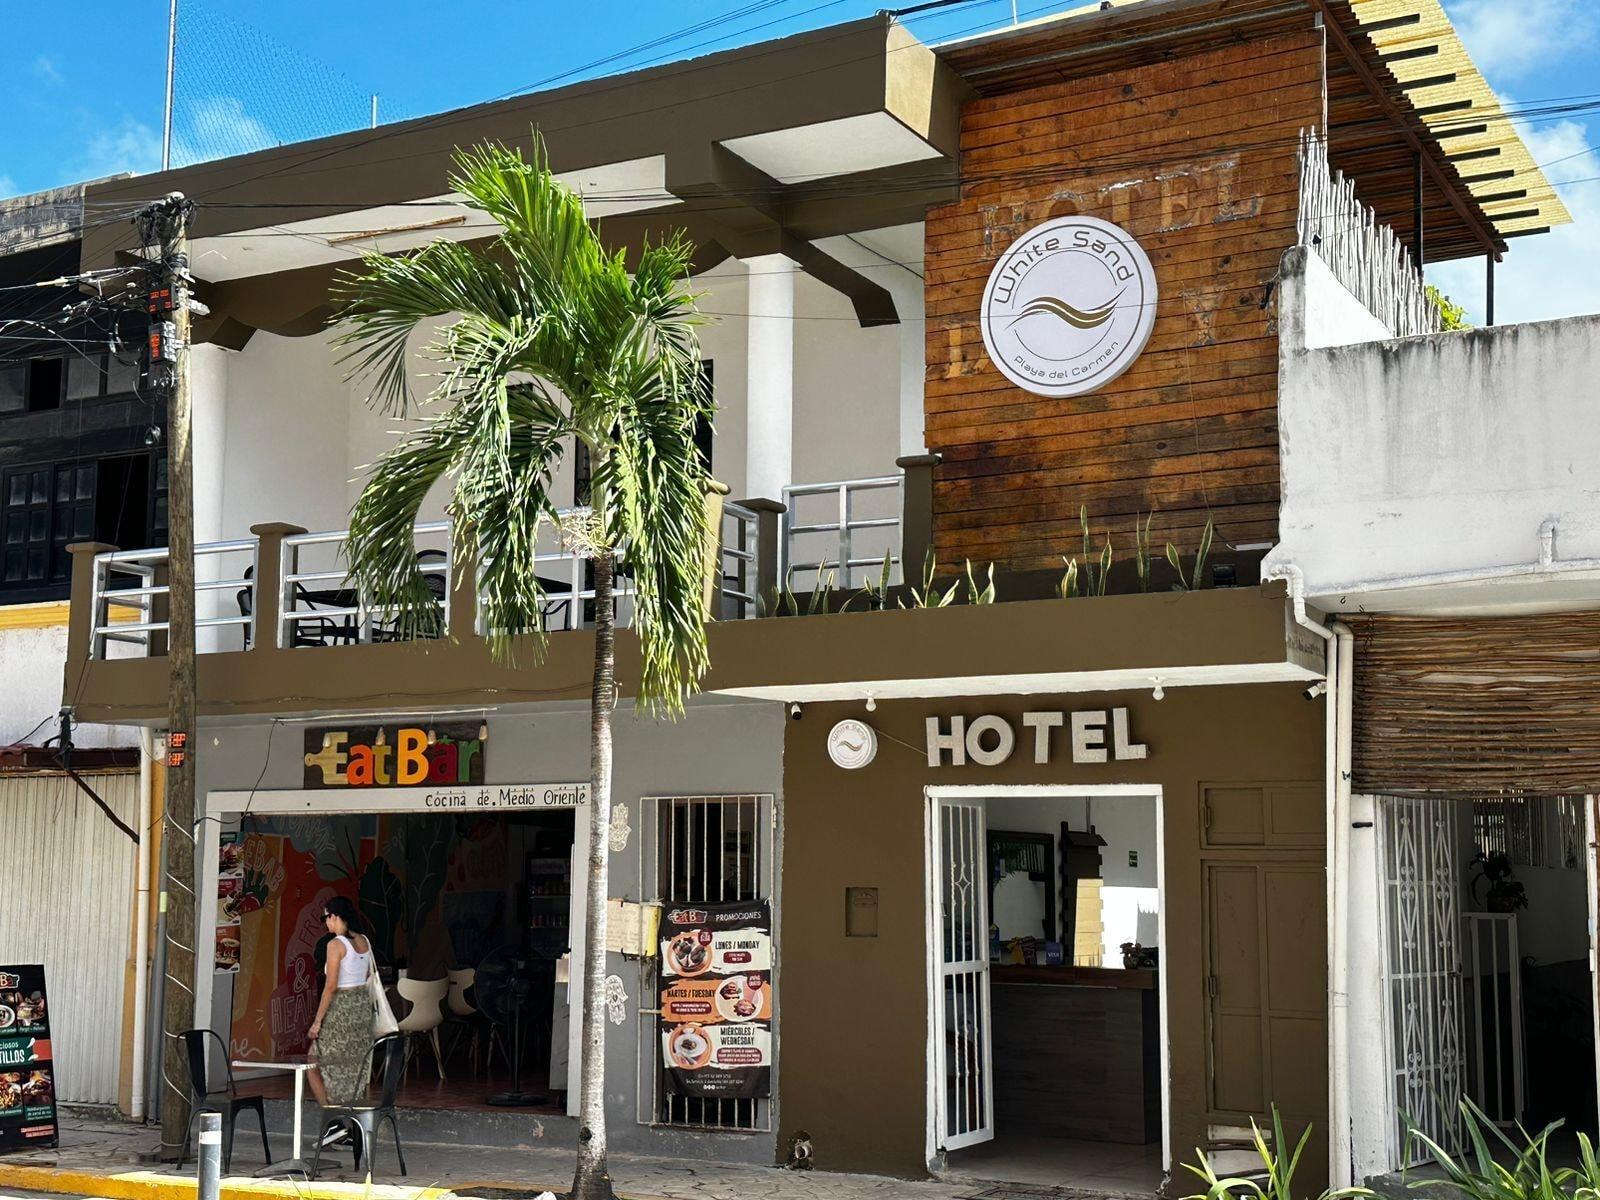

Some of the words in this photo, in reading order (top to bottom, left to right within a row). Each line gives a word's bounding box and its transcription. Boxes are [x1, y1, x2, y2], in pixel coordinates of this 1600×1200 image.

[994, 237, 1060, 304] White
[1073, 230, 1135, 281] Sand
[1013, 355, 1046, 377] Playa
[1048, 367, 1069, 379] del
[1071, 340, 1119, 377] Carmen
[926, 707, 1148, 768] HOTEL
[425, 791, 466, 807] Cocina
[500, 787, 536, 806] Medio
[715, 911, 762, 921] PROMOCIONES
[715, 941, 732, 950] LUNES
[737, 940, 760, 949] MONDAY
[667, 989, 688, 998] MARTES
[692, 989, 716, 998] TUESDAY
[271, 989, 319, 1034] HEAL
[720, 1037, 755, 1046] WEDNESDAY
